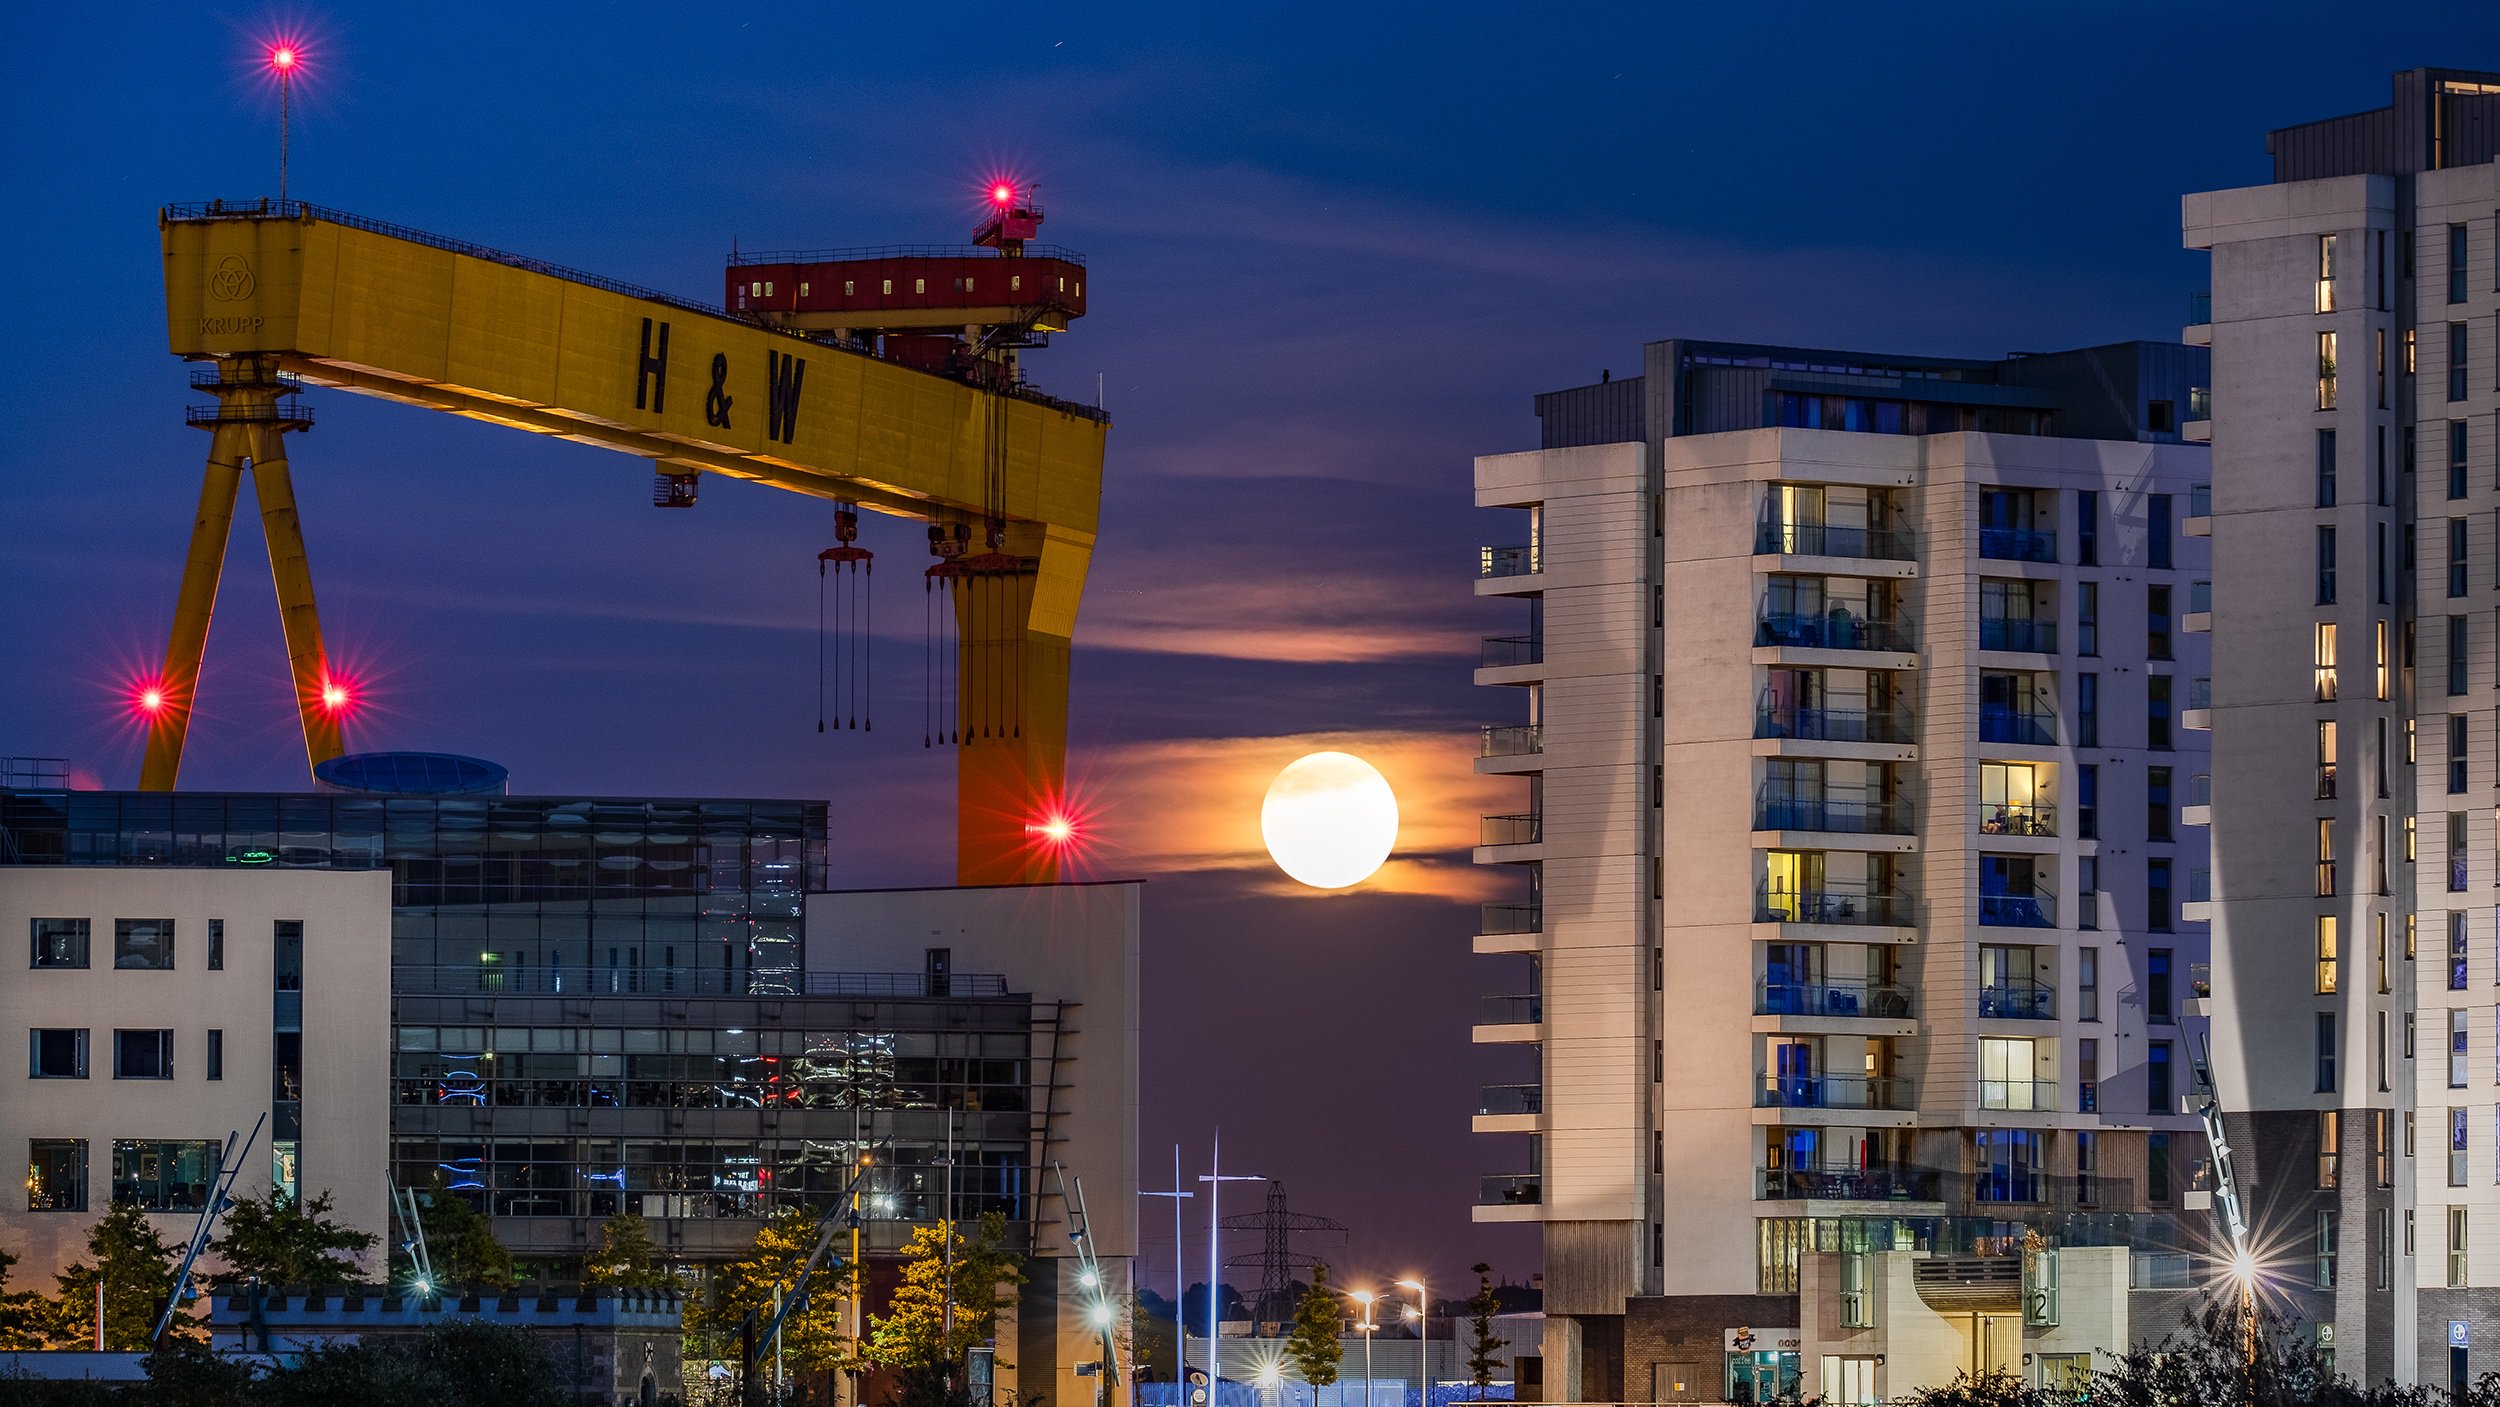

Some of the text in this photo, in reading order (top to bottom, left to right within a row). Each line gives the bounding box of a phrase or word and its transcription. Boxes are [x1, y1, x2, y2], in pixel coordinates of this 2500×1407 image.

[200, 316, 264, 335] KRUPP
[636, 317, 806, 445] H & W
[1845, 1296, 1859, 1323] 11
[2026, 1293, 2047, 1320] 12
[1731, 1355, 1751, 1365] coffee
